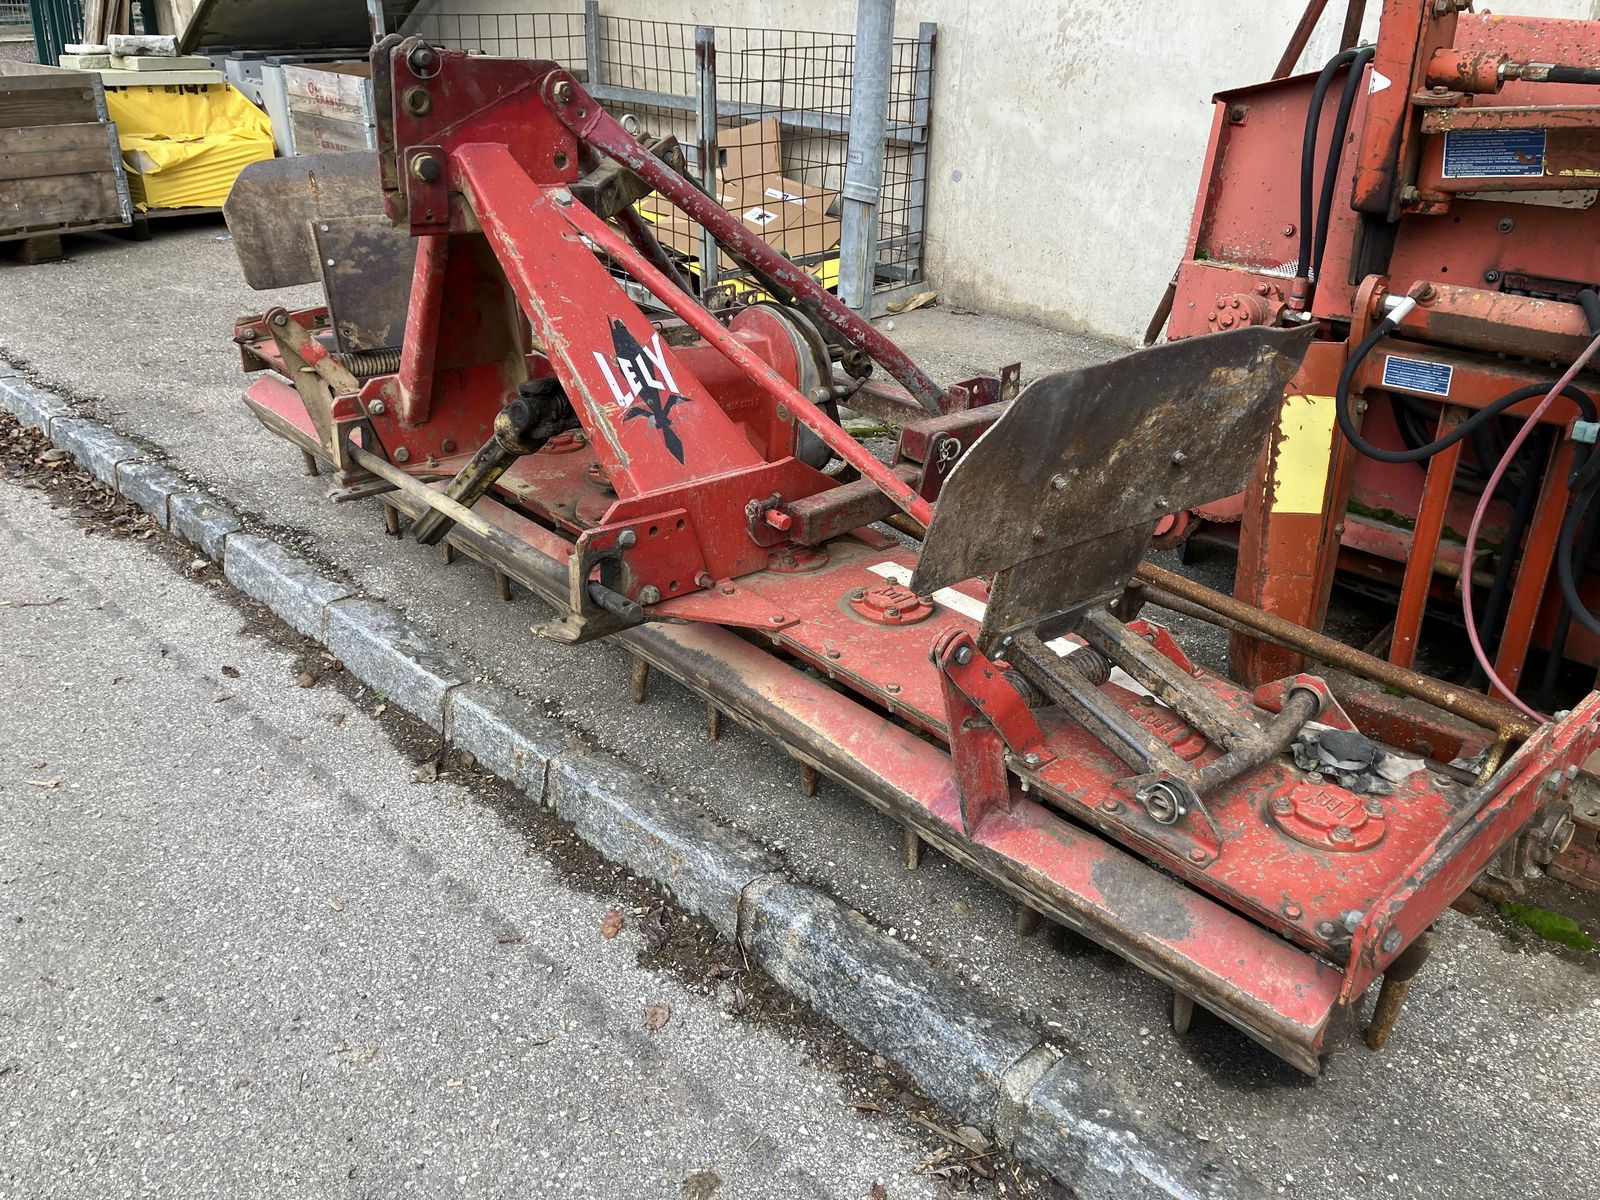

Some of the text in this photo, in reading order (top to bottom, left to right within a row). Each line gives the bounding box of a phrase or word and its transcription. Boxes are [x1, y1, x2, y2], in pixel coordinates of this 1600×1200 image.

[315, 95, 343, 108] GRANIT
[592, 332, 680, 408] LELY
[1301, 789, 1357, 819] LELY
